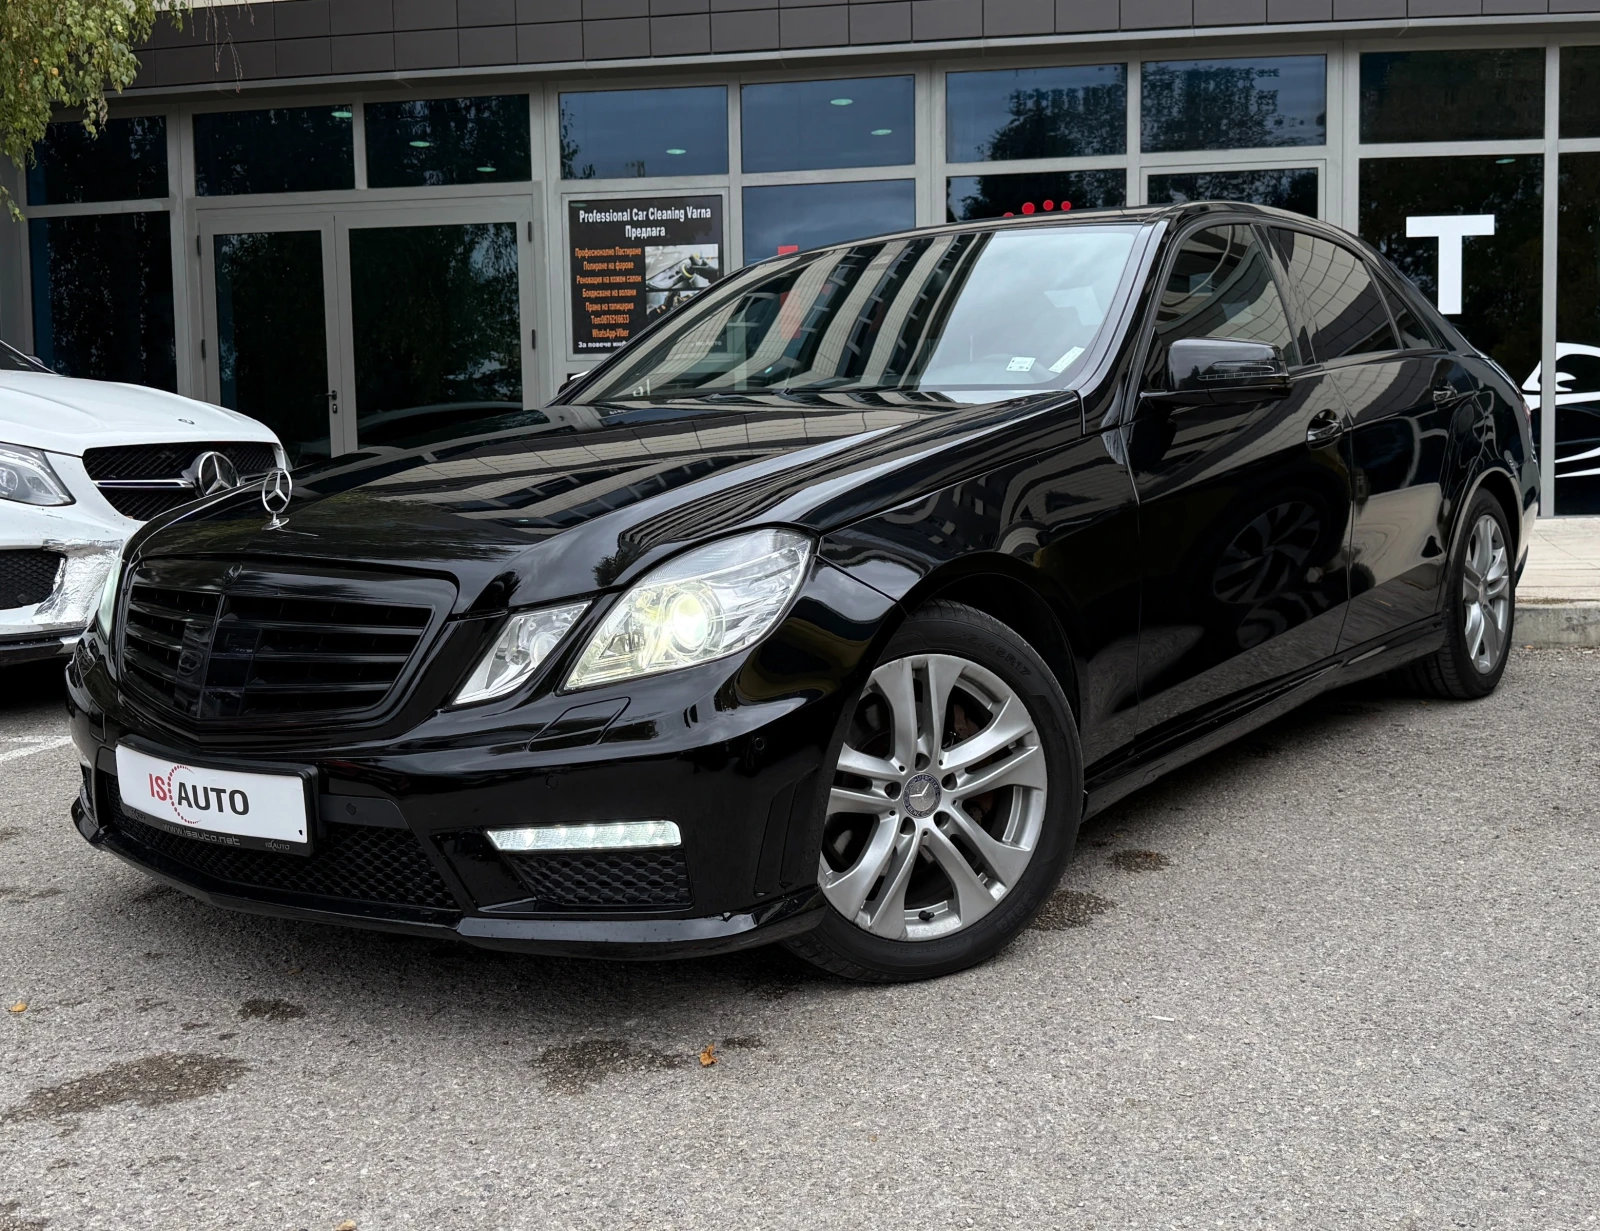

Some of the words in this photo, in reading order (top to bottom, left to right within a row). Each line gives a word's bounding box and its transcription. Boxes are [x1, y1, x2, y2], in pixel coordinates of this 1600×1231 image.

[579, 209, 630, 223] Professional
[632, 210, 647, 221] Car
[649, 207, 685, 222] Cleaning
[686, 206, 711, 219] Varna
[625, 225, 666, 240] Предлага
[575, 248, 615, 258] Професионално
[583, 261, 607, 271] Полиране
[615, 261, 634, 271] фарове
[585, 302, 601, 311] Пране
[149, 773, 168, 801] IS
[177, 782, 250, 816] AUTO
[163, 823, 240, 846] www.isauto.net
